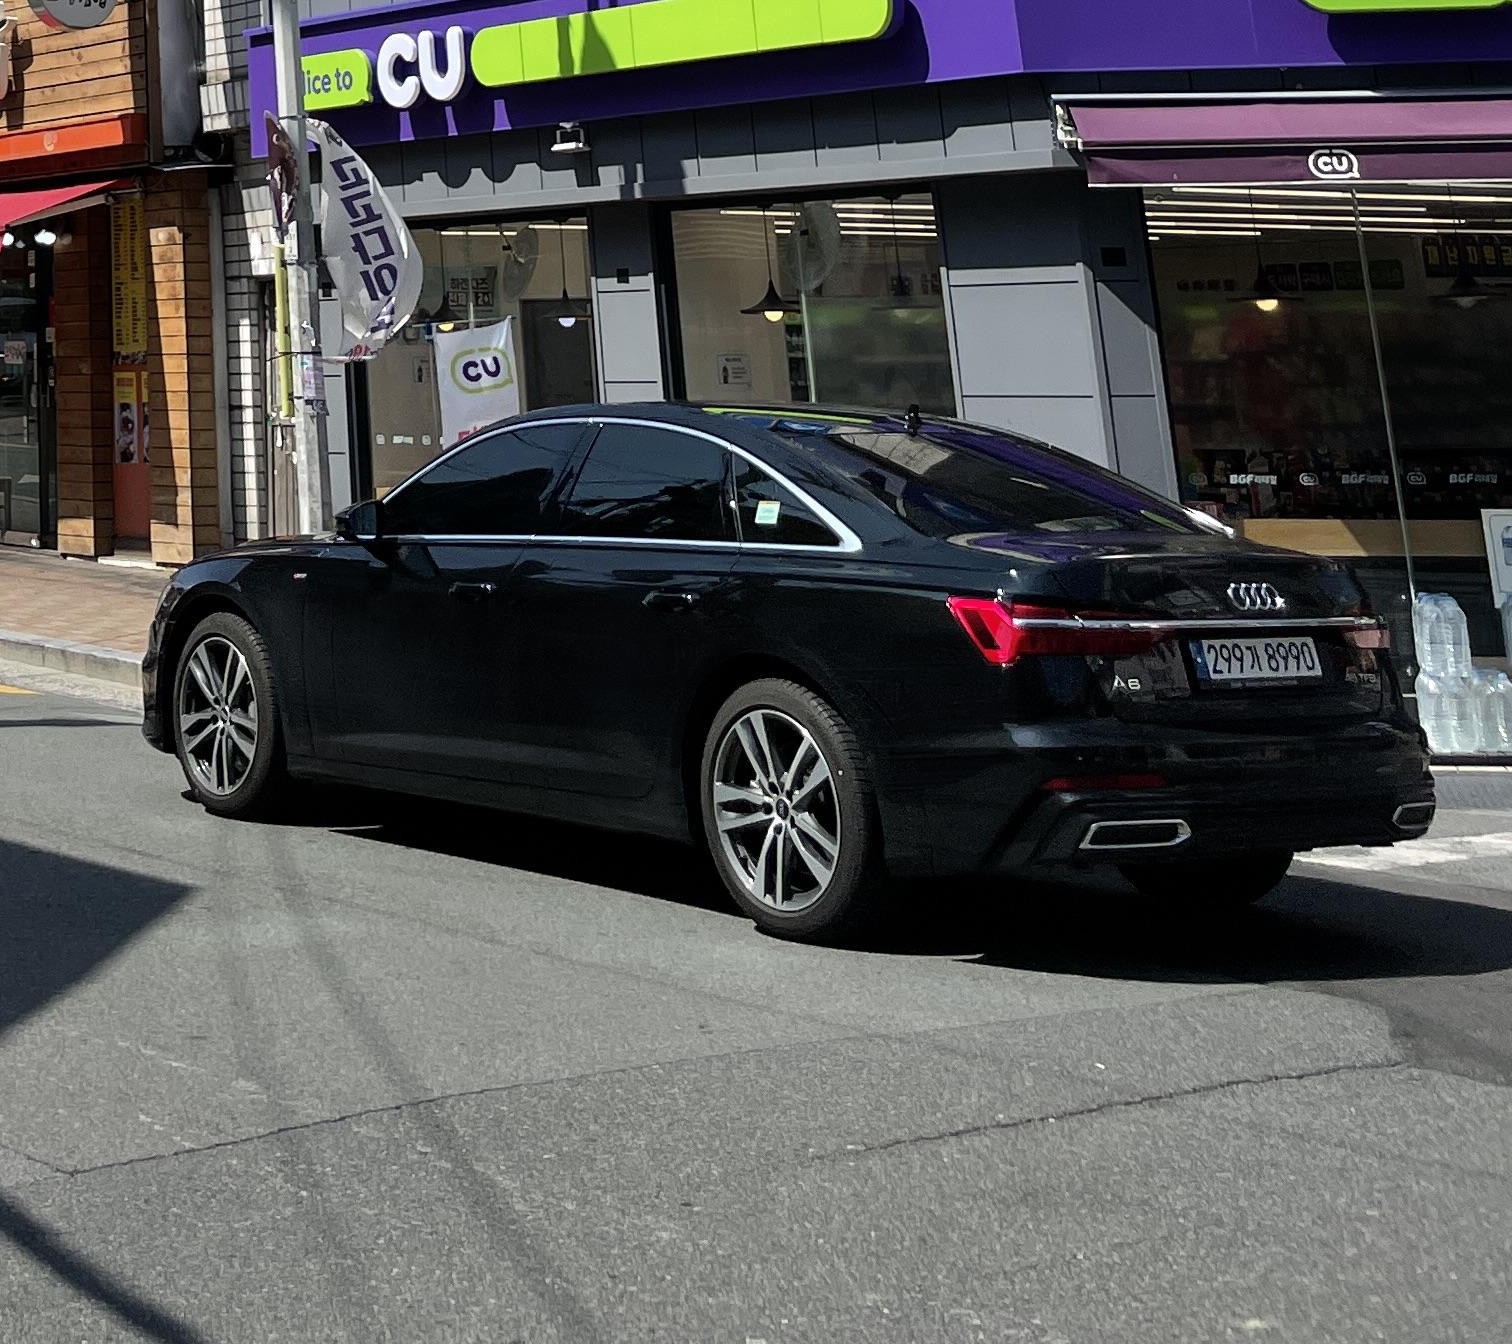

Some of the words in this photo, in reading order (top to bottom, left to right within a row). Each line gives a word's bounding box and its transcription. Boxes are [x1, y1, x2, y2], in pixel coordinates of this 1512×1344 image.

[334, 67, 353, 92] to
[377, 26, 466, 109] CU
[1317, 155, 1348, 173] CU
[462, 356, 501, 382] CU
[1264, 642, 1316, 672] 8990
